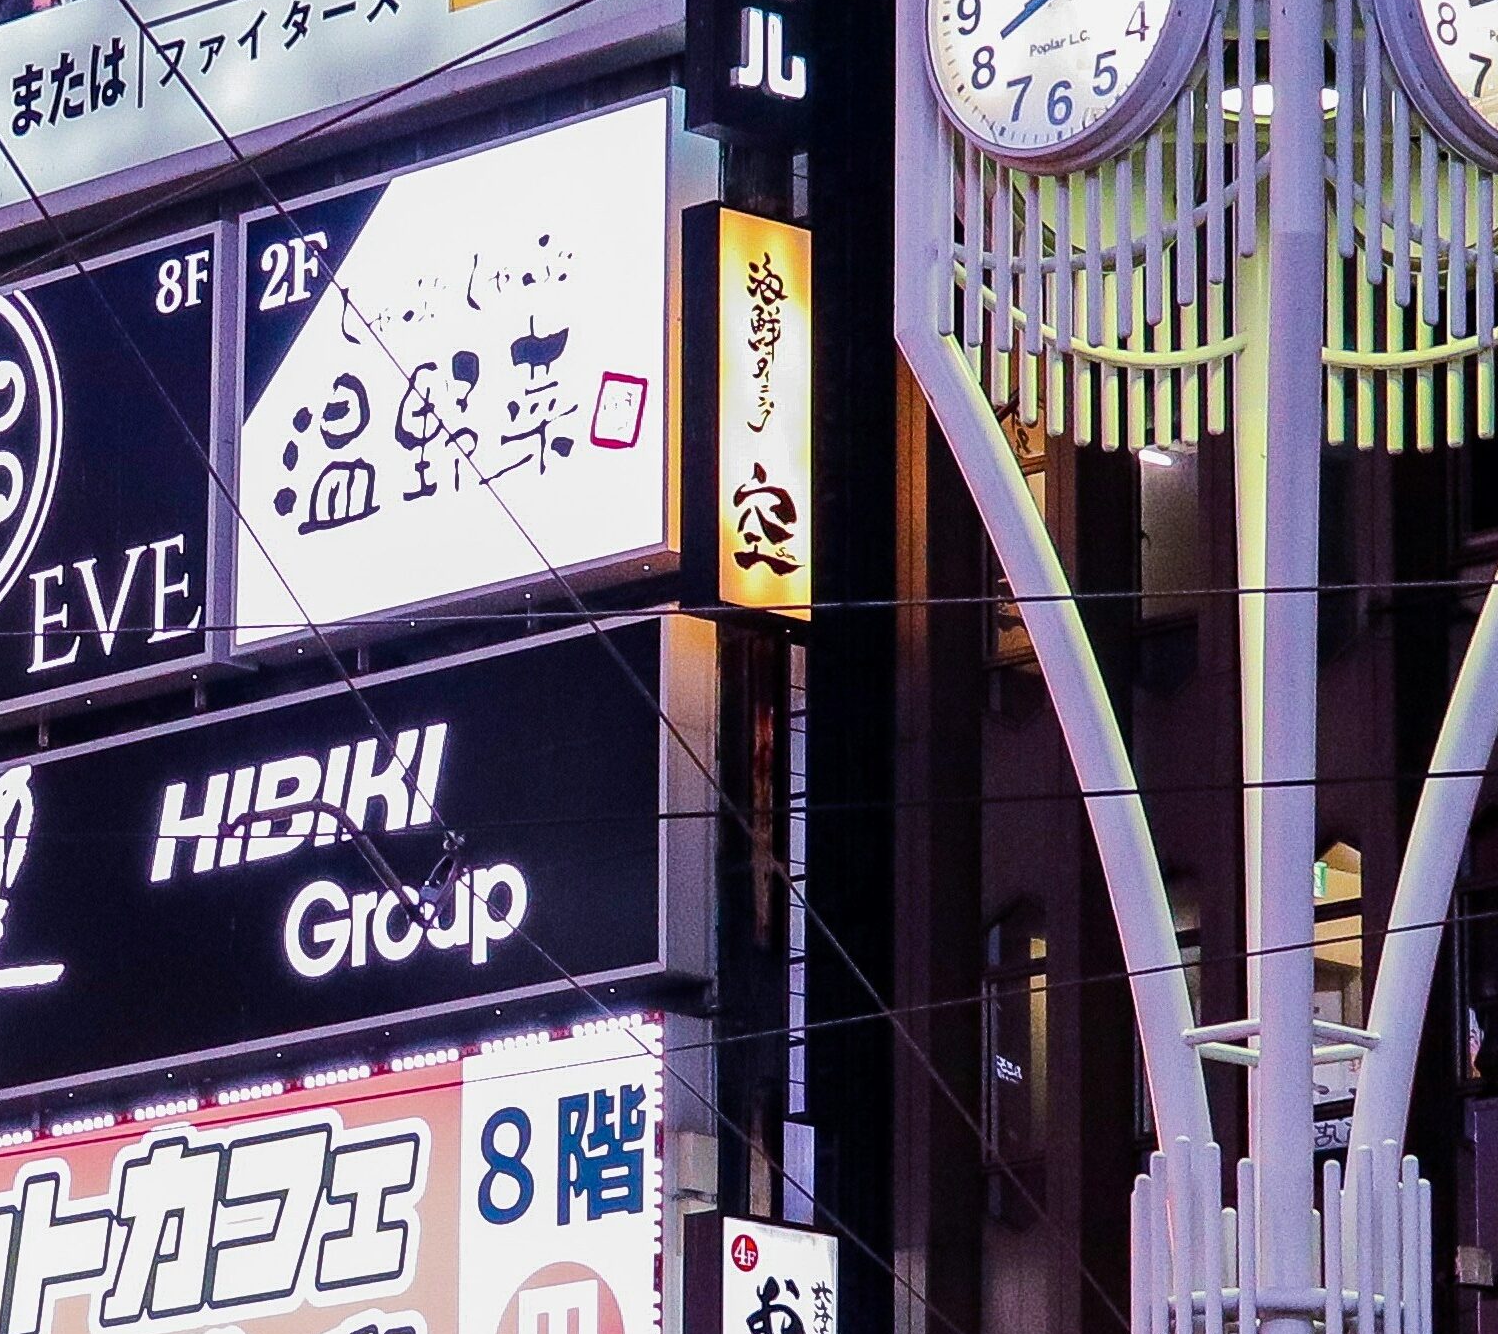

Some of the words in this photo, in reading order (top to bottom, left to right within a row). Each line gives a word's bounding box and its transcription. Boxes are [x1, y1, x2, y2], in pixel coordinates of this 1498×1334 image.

[1125, 1, 1151, 41] 4
[1437, 1, 1458, 45] 8
[970, 47, 996, 90] 8
[1029, 37, 1066, 57] Poplar
[10, 42, 126, 136] または
[1091, 52, 1118, 96] 5
[1469, 54, 1493, 98] 7
[1007, 77, 1033, 123] 7
[1047, 80, 1074, 126] 6
[155, 251, 210, 315] 8F
[259, 231, 330, 314] 2F
[26, 535, 204, 675] EVE
[149, 722, 449, 883] HIBIKI
[282, 863, 528, 979] Group
[476, 1083, 648, 1228] 8階
